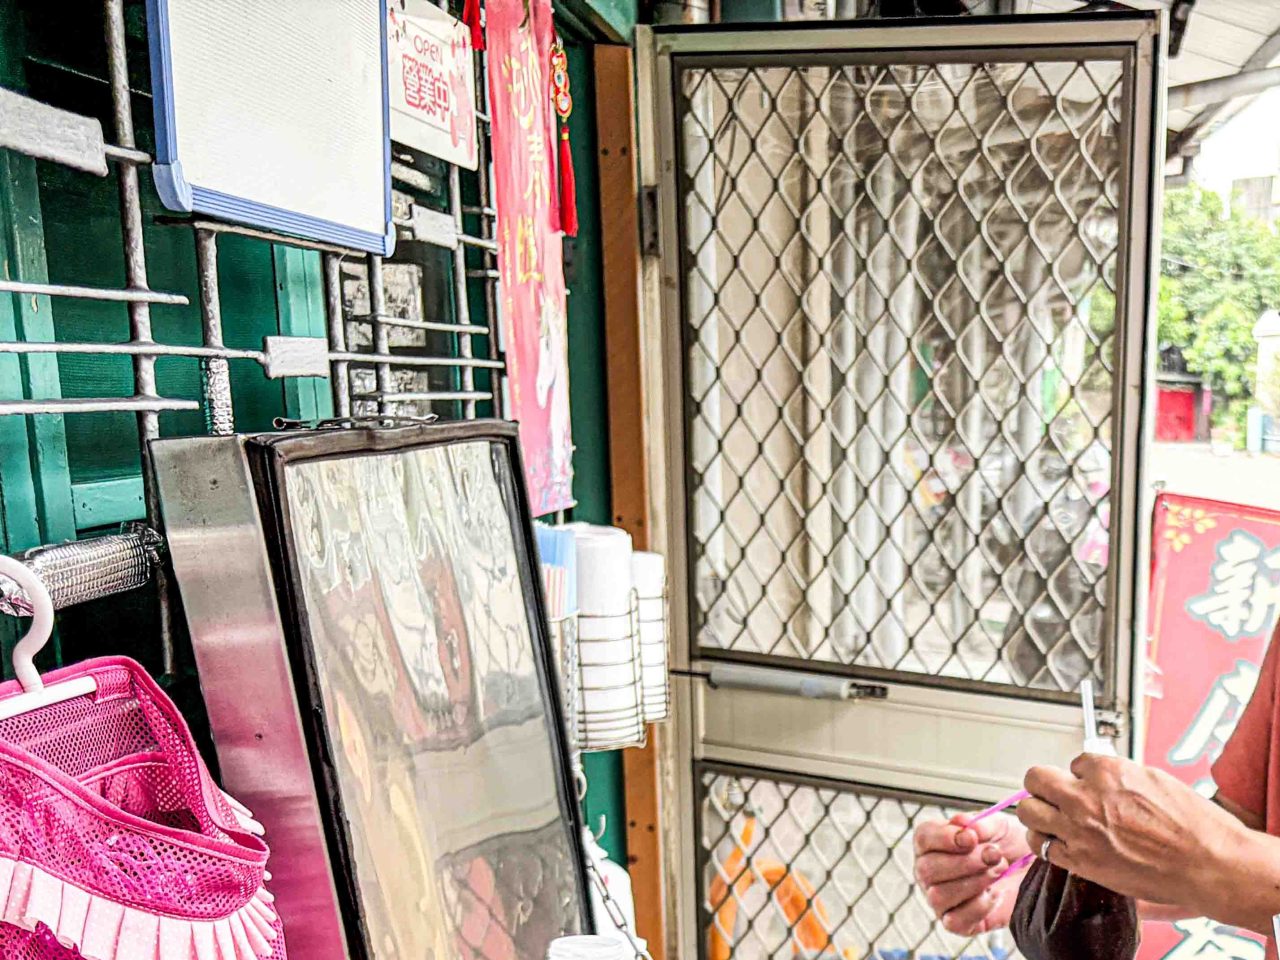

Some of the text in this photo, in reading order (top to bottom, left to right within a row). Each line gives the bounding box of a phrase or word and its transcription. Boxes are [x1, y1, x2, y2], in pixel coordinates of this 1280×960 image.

[413, 34, 444, 66] OPEN
[402, 52, 450, 122] 營業中
